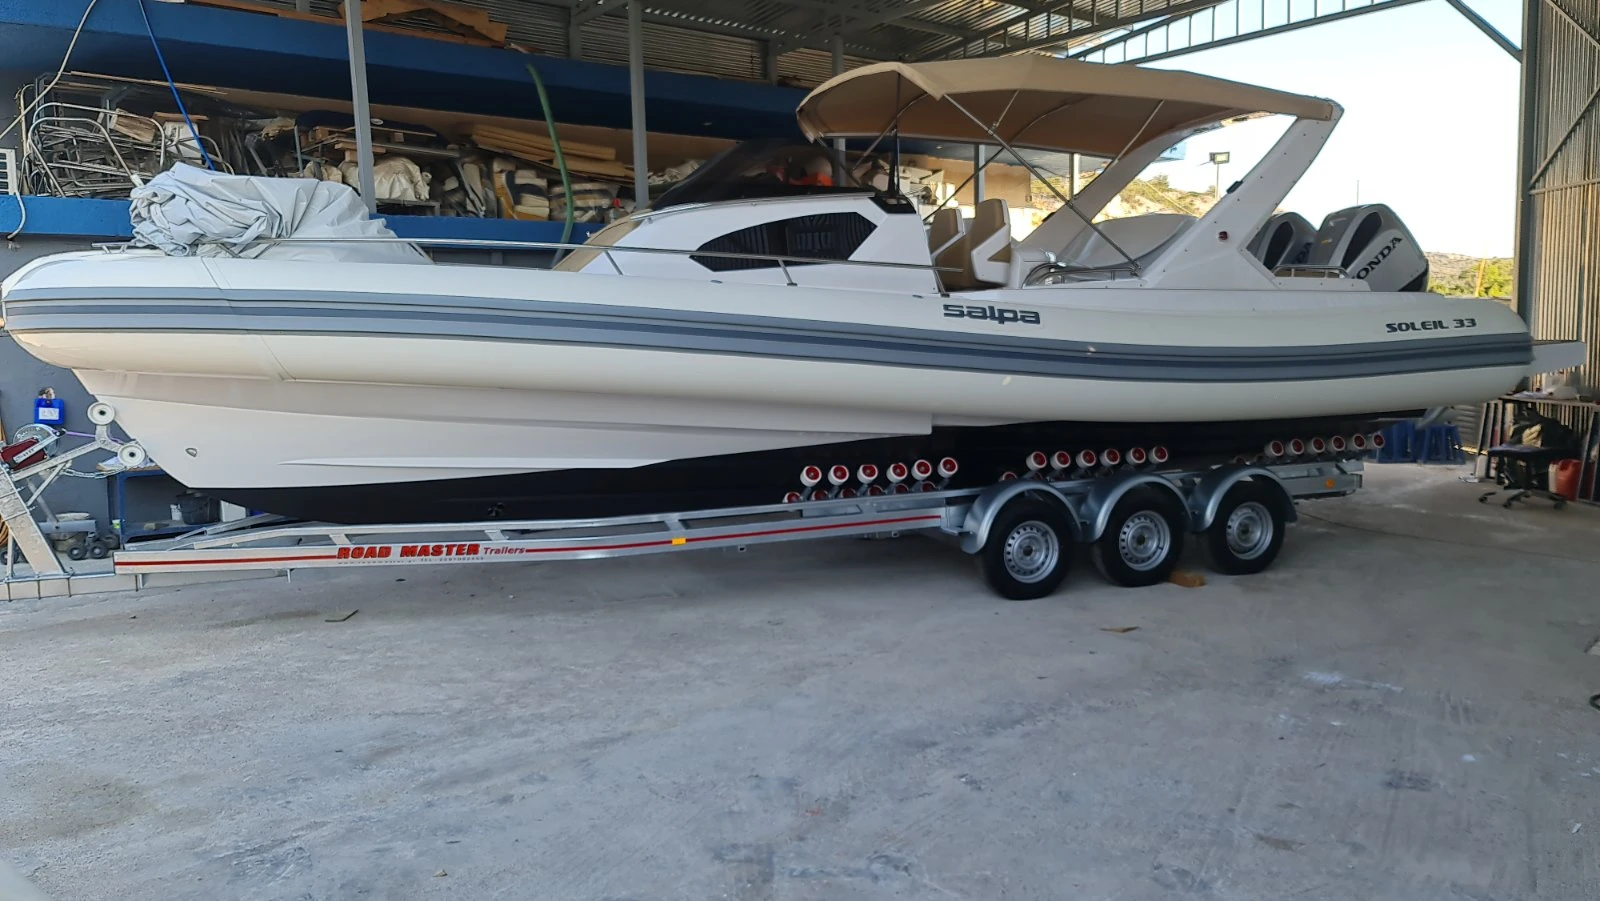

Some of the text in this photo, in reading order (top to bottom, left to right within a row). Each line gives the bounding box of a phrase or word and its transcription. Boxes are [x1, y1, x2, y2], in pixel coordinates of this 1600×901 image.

[1352, 237, 1403, 280] ONDA
[942, 304, 1041, 324] salpa
[1385, 318, 1477, 333] SOLEIL 33
[336, 543, 526, 559] ROAD MASTER Trailers
